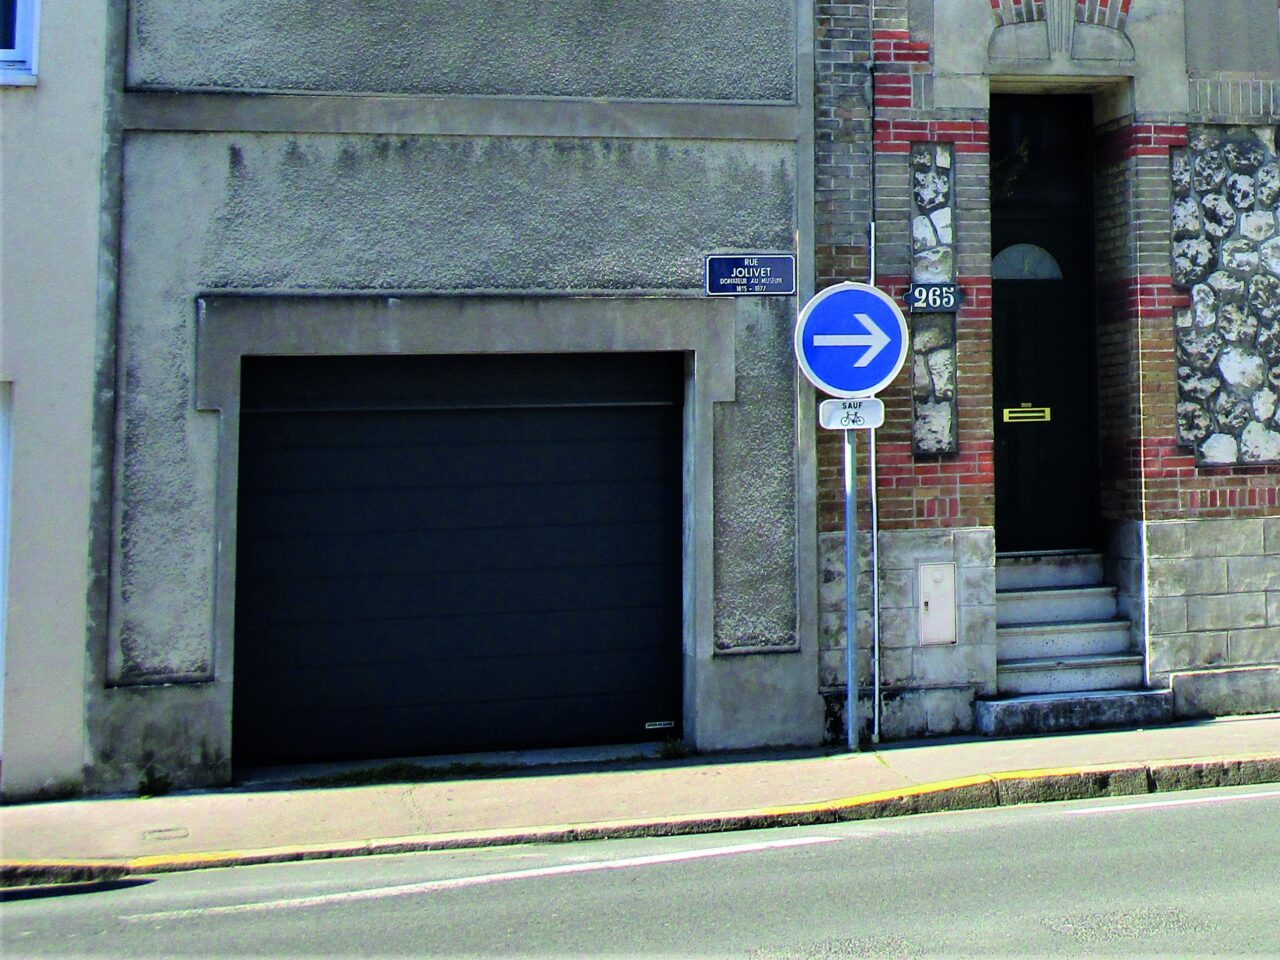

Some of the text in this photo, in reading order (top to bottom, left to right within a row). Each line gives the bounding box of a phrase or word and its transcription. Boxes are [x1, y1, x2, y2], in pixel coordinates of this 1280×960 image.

[744, 258, 758, 266] RUE
[731, 268, 771, 277] JOLIVET
[914, 287, 954, 308] 265
[842, 401, 863, 409] SAUF
